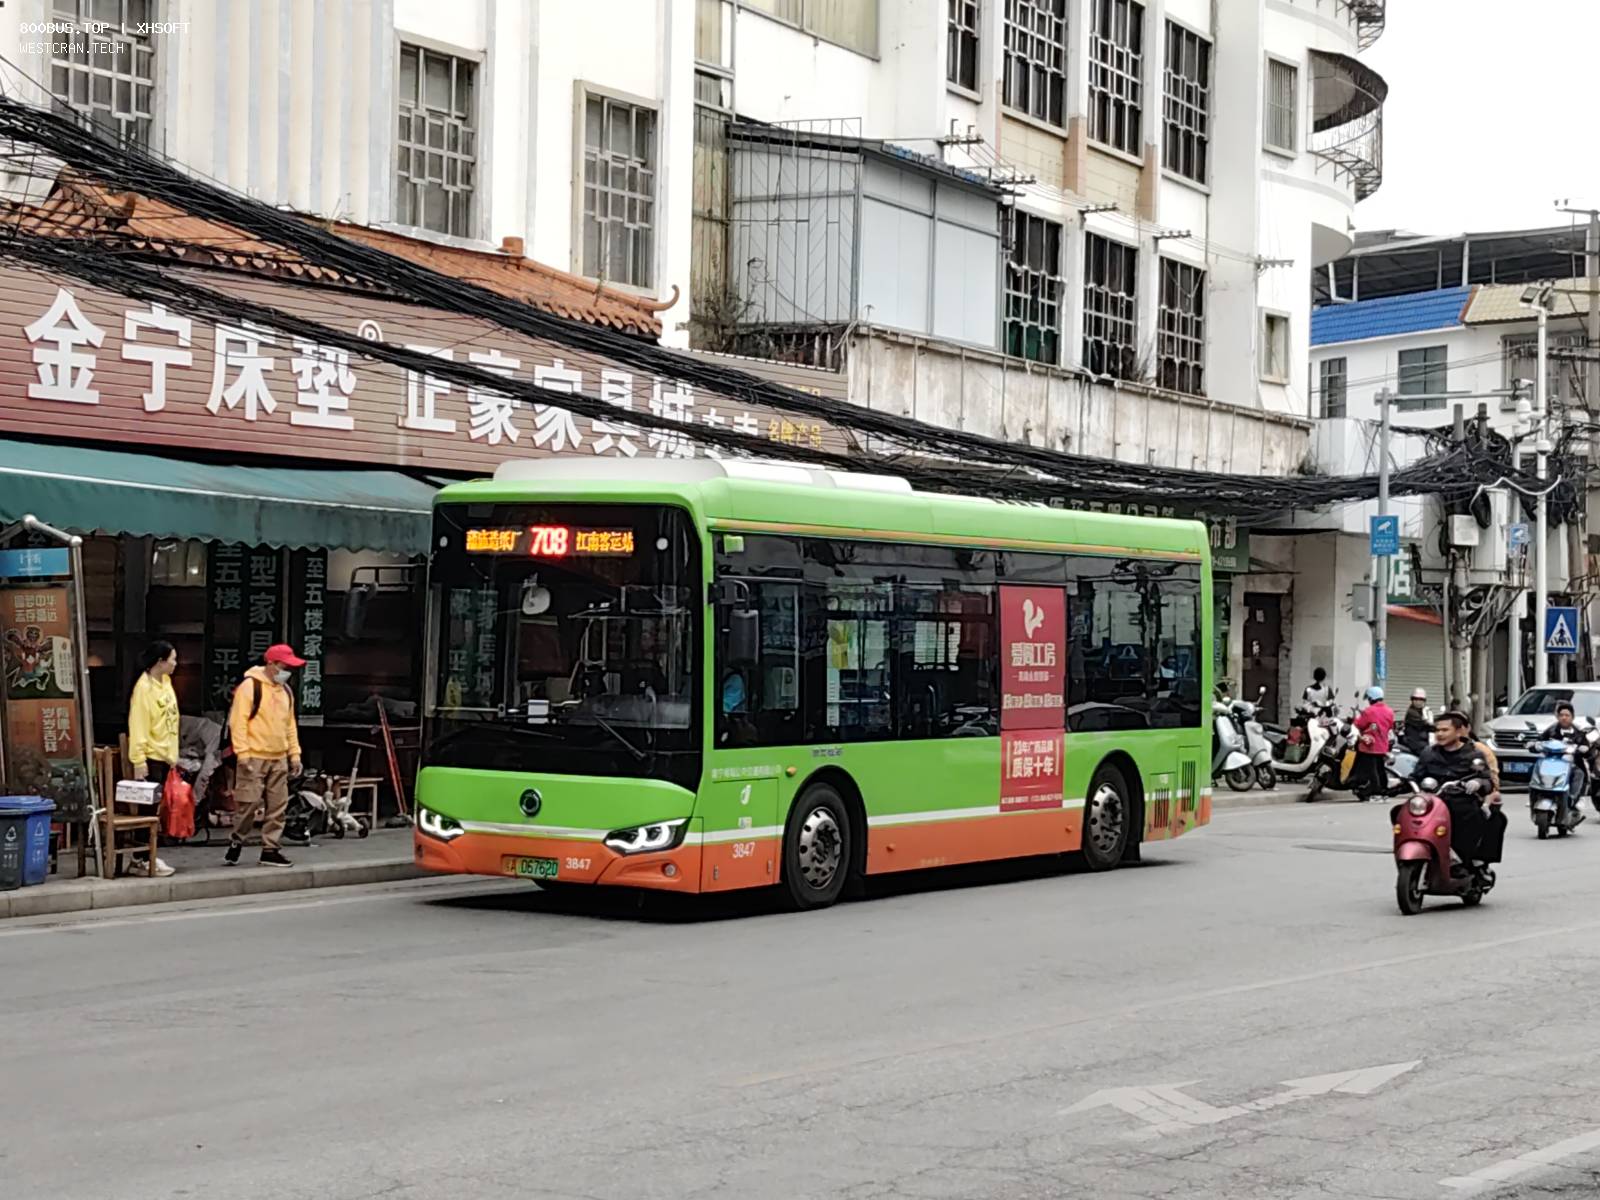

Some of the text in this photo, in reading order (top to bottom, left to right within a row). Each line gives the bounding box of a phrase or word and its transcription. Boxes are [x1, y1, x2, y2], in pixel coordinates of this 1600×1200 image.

[23, 288, 357, 430] 金宁床垫
[530, 527, 568, 555] 708
[302, 557, 325, 709] 至五楼家具城
[565, 857, 591, 870] 3847
[732, 842, 755, 858] 3847
